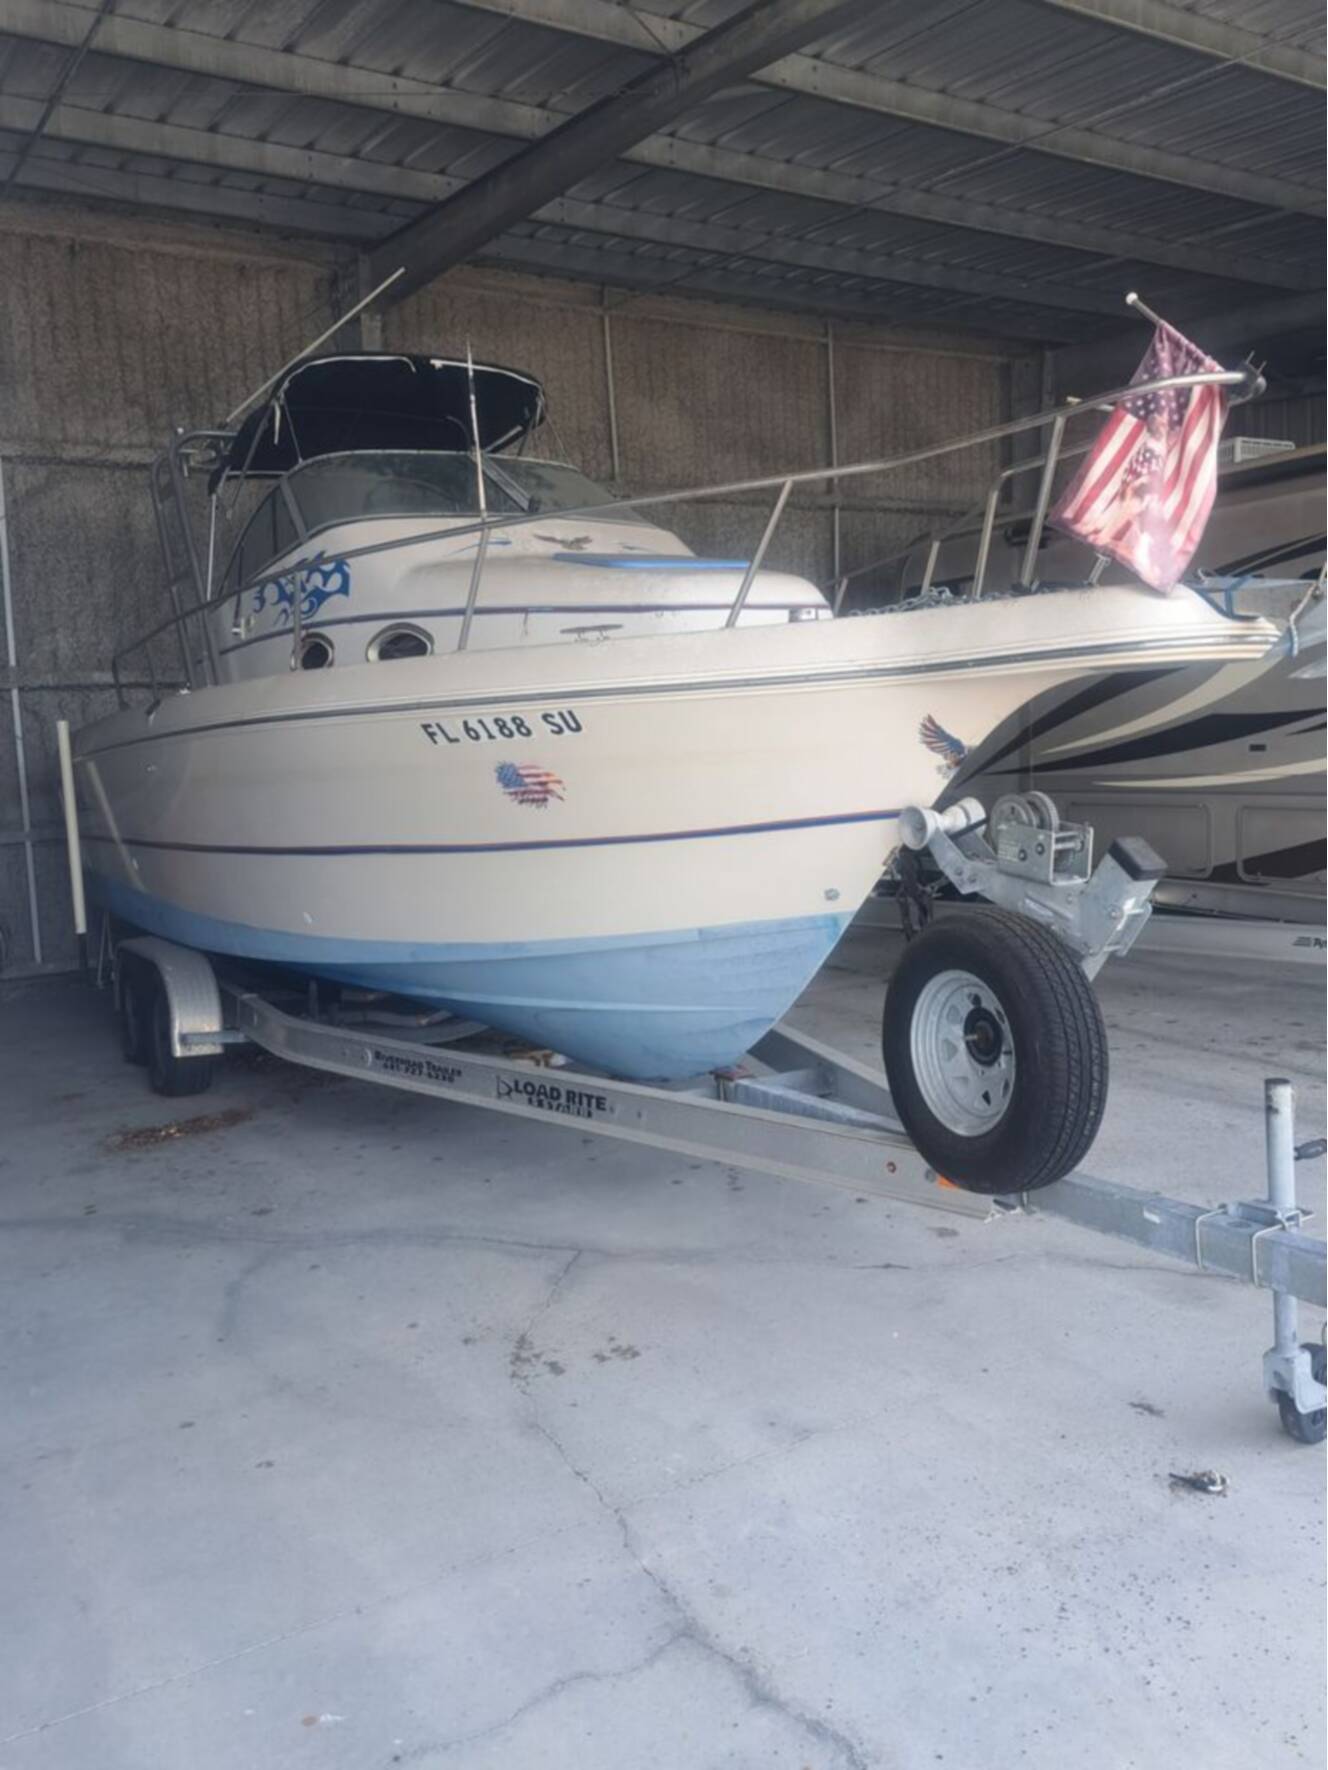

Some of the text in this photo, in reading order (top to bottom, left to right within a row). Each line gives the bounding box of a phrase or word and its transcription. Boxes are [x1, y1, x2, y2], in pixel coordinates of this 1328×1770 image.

[420, 710, 583, 745] FL 6188 SU
[513, 1079, 561, 1101] LOAD
[565, 1089, 607, 1112] RITE
